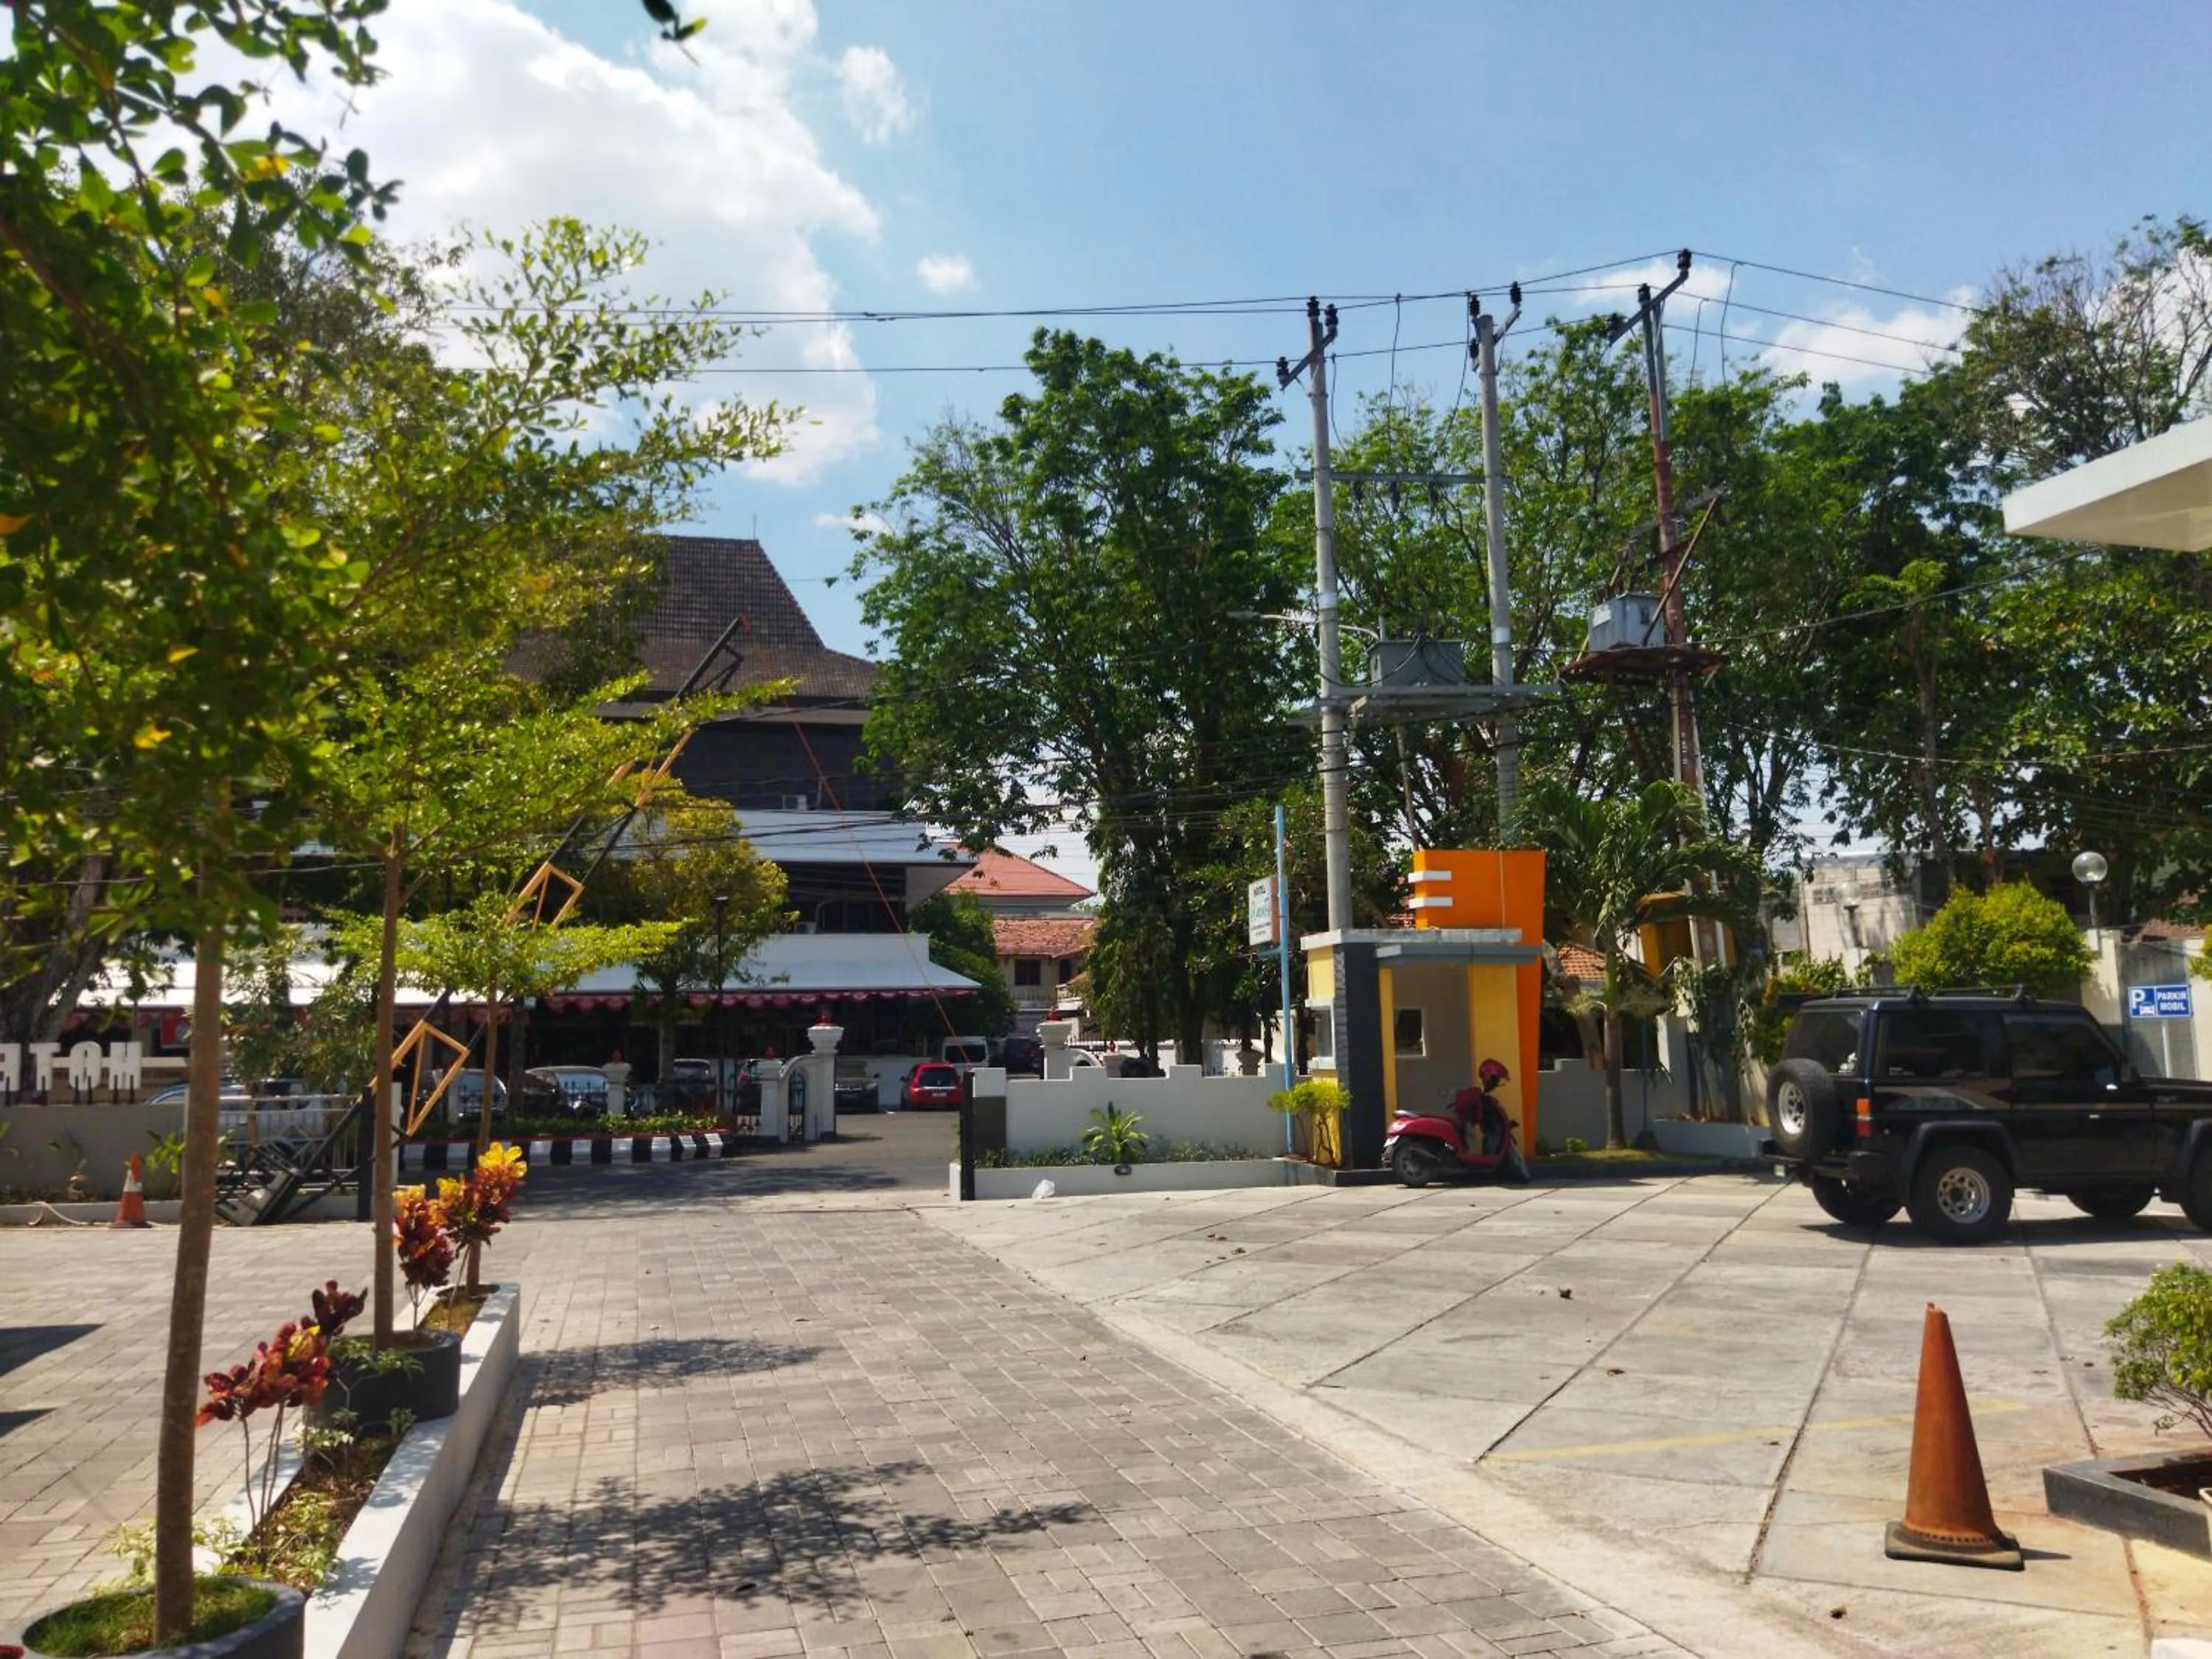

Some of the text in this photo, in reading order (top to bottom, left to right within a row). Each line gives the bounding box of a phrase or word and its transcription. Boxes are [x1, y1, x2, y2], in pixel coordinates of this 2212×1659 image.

[2132, 989, 2146, 1009] P
[2157, 991, 2186, 1001] PARKIR
[2160, 1002, 2187, 1011] MOBIL
